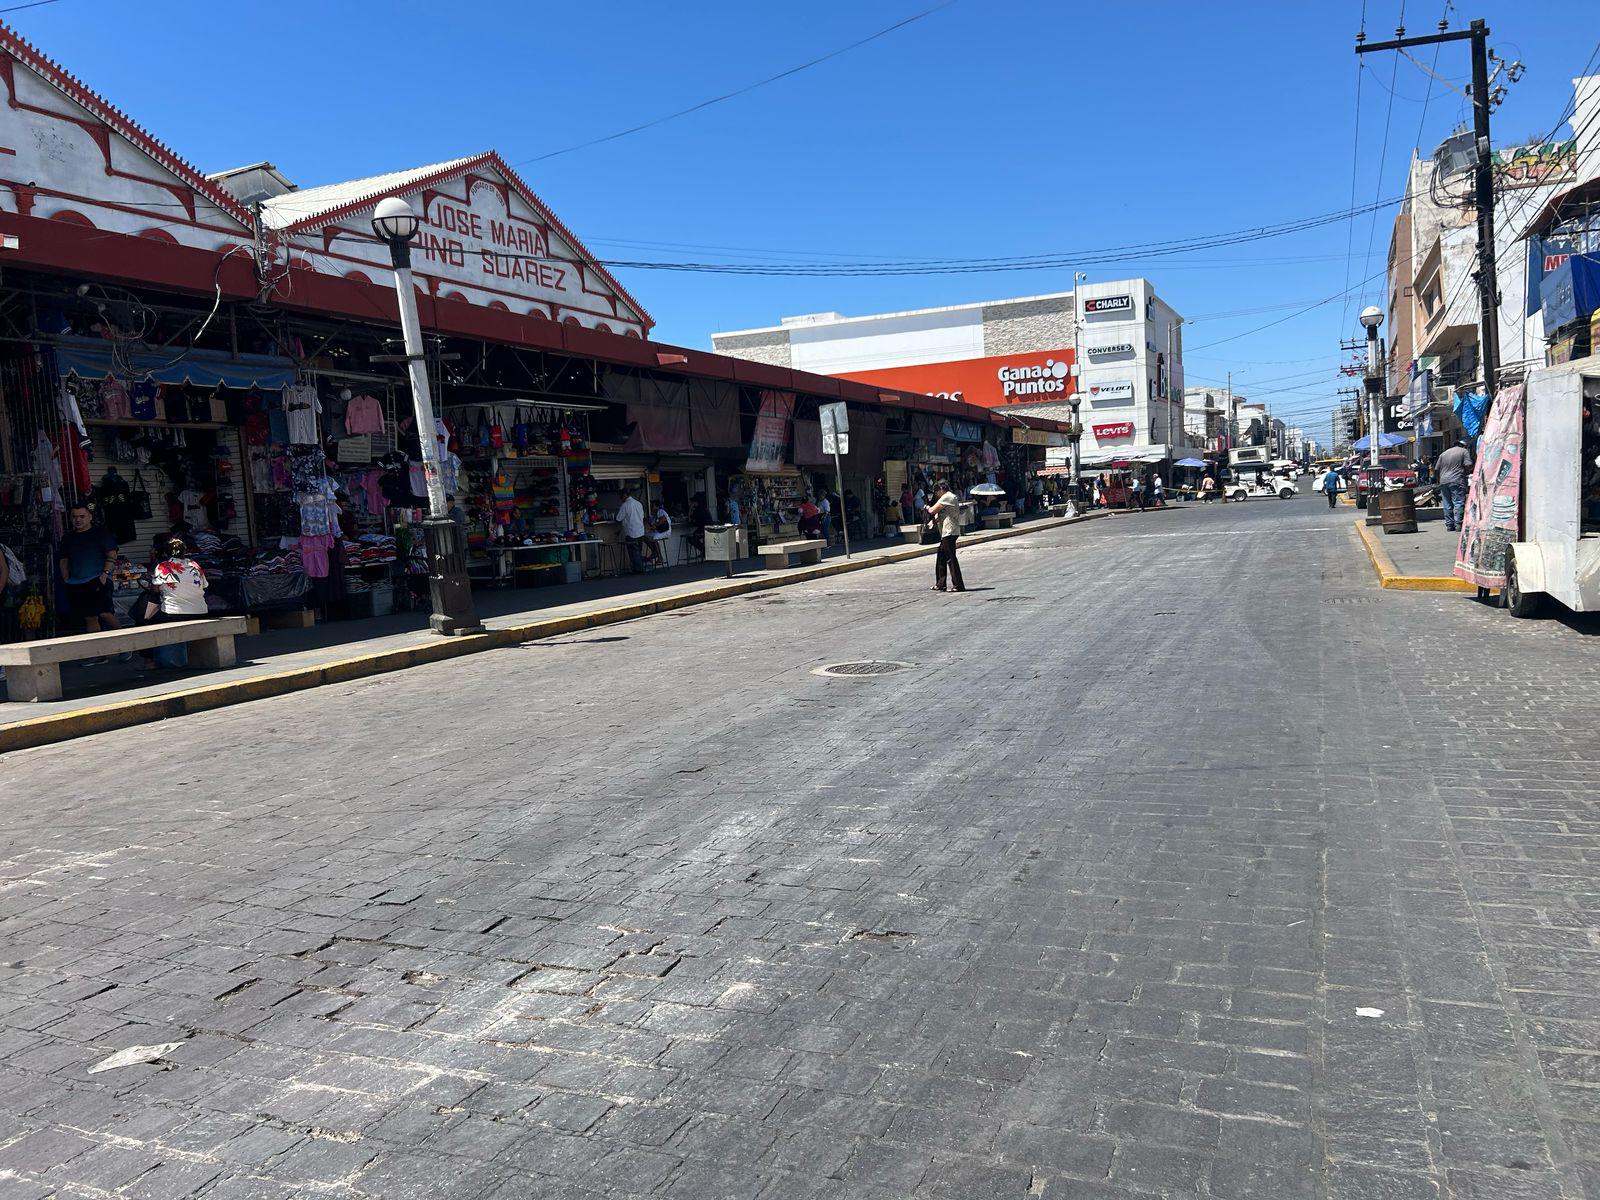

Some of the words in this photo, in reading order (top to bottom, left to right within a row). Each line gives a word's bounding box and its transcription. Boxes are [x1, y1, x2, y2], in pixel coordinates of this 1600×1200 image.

[431, 203, 482, 240] JOSE
[491, 220, 546, 258] MARIA
[481, 248, 566, 291] SUAREZ
[1096, 298, 1128, 309] CHARLY
[1088, 345, 1125, 354] CONVERSE
[998, 365, 1042, 381] Gana
[1004, 378, 1065, 396] Puntos
